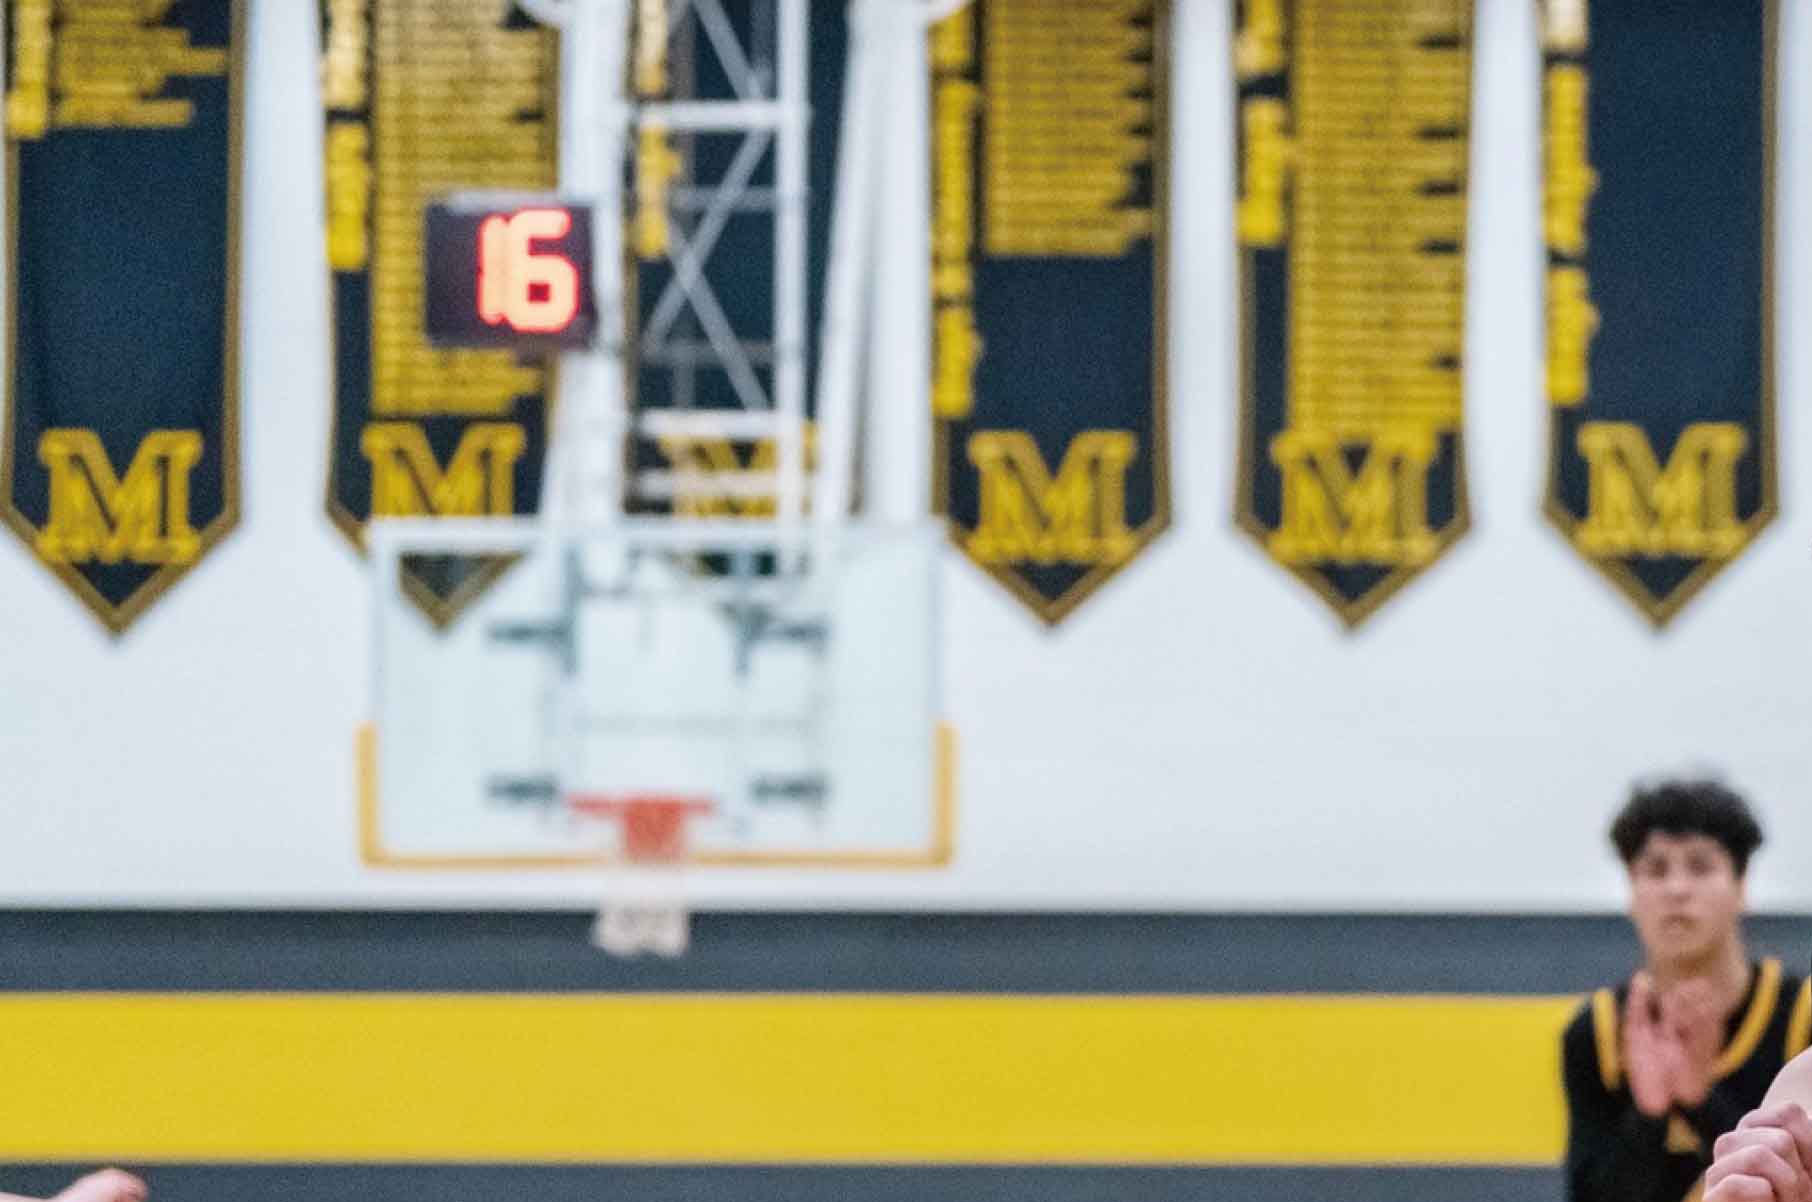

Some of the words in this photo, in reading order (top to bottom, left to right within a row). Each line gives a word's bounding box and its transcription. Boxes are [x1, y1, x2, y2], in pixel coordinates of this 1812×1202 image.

[478, 208, 578, 332] 16
[38, 428, 204, 565] M
[967, 428, 1136, 566] M
[1270, 425, 1437, 564] M
[1575, 420, 1750, 561] M
